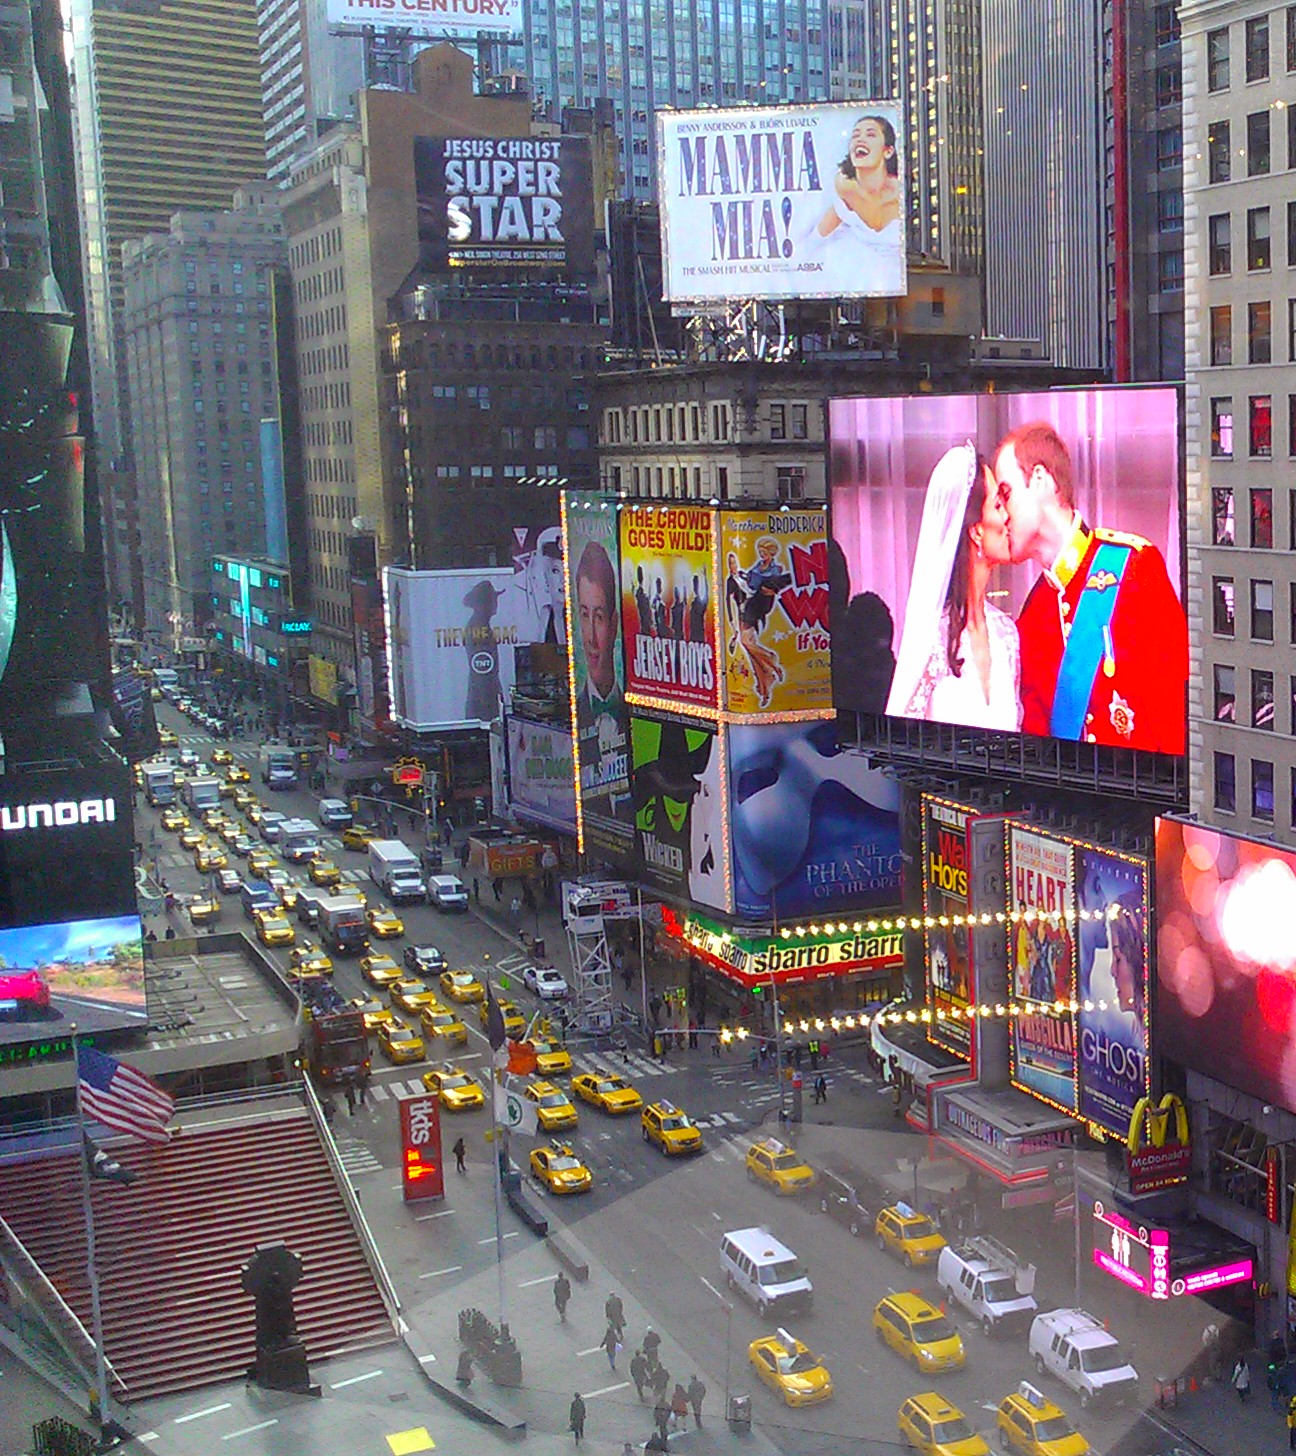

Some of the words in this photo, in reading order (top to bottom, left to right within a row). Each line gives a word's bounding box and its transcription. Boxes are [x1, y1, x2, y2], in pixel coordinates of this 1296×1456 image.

[677, 124, 700, 134] BENNY
[703, 121, 747, 132] ANDERSSON
[750, 120, 757, 130] &
[443, 140, 493, 159] JESUS
[497, 141, 561, 159] CHRIST
[678, 131, 823, 197] MAMMA
[445, 160, 563, 197] SUPER
[447, 196, 566, 242] STAR
[709, 196, 795, 261] MIA!
[682, 267, 696, 276] THE
[697, 265, 724, 275] SMASH
[725, 265, 737, 275] HIT
[739, 264, 771, 274] MUSICAL
[657, 510, 711, 530] CROWD
[768, 515, 825, 534] BRODERICK
[628, 528, 666, 550] GOES
[492, 625, 519, 646] BAC
[797, 633, 809, 651] If
[812, 633, 831, 650] Yo
[474, 660, 491, 668] TNT
[633, 634, 677, 684] JERSEY
[679, 640, 714, 691] BOYS
[491, 856, 535, 872] GIFTS
[641, 832, 683, 872] WICKED
[853, 843, 879, 857] THE
[938, 829, 966, 871] Wa
[806, 852, 902, 884] PHANTO
[929, 851, 968, 896] Hors
[814, 885, 831, 898] OF
[837, 881, 868, 895] THE
[1016, 866, 1067, 914] HEART
[719, 942, 749, 971] sbarro
[754, 945, 830, 973] sbarro
[1082, 1028, 1145, 1083] GHOST
[409, 1100, 433, 1145] tkts
[1131, 1150, 1190, 1169] McDonald's
